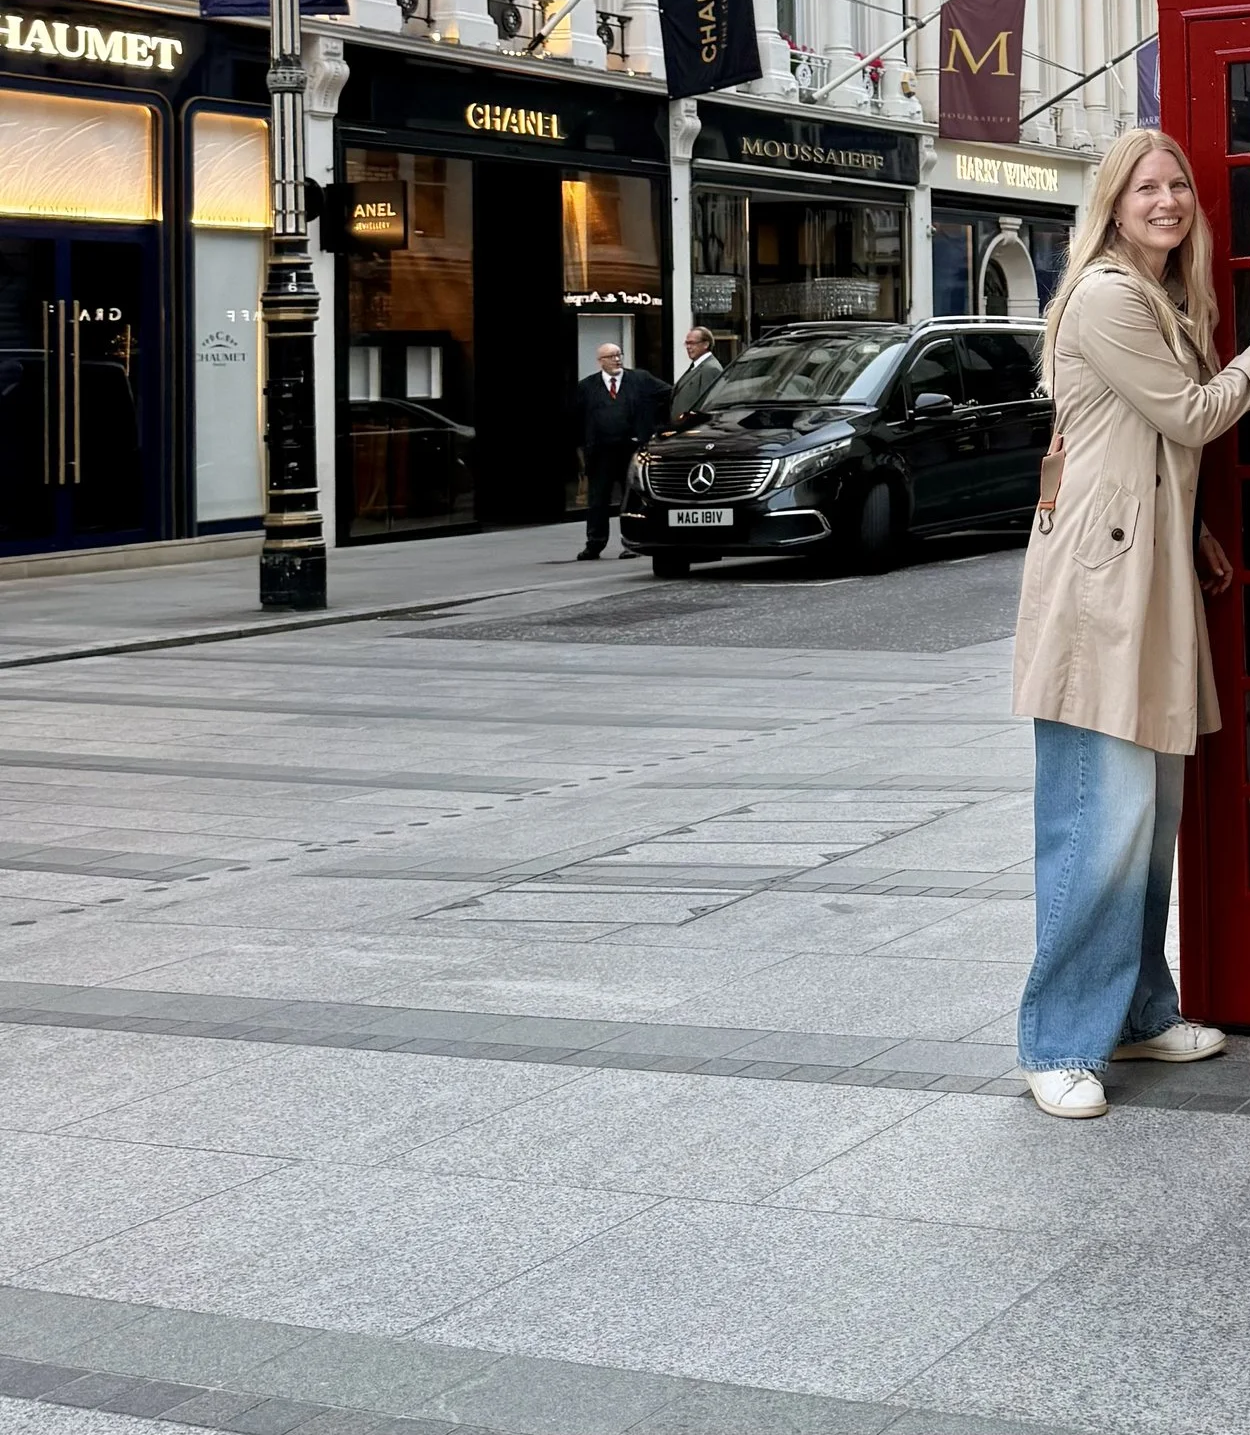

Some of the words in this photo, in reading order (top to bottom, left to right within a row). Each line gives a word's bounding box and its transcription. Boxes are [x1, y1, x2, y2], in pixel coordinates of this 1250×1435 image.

[941, 28, 1015, 75] M
[464, 102, 567, 140] CHANEL
[741, 136, 884, 171] MOUSSAIEFF
[956, 154, 1001, 184] HARRY
[1003, 161, 1058, 192] WINSTON
[353, 202, 396, 217] ANEL
[677, 511, 699, 524] MAG
